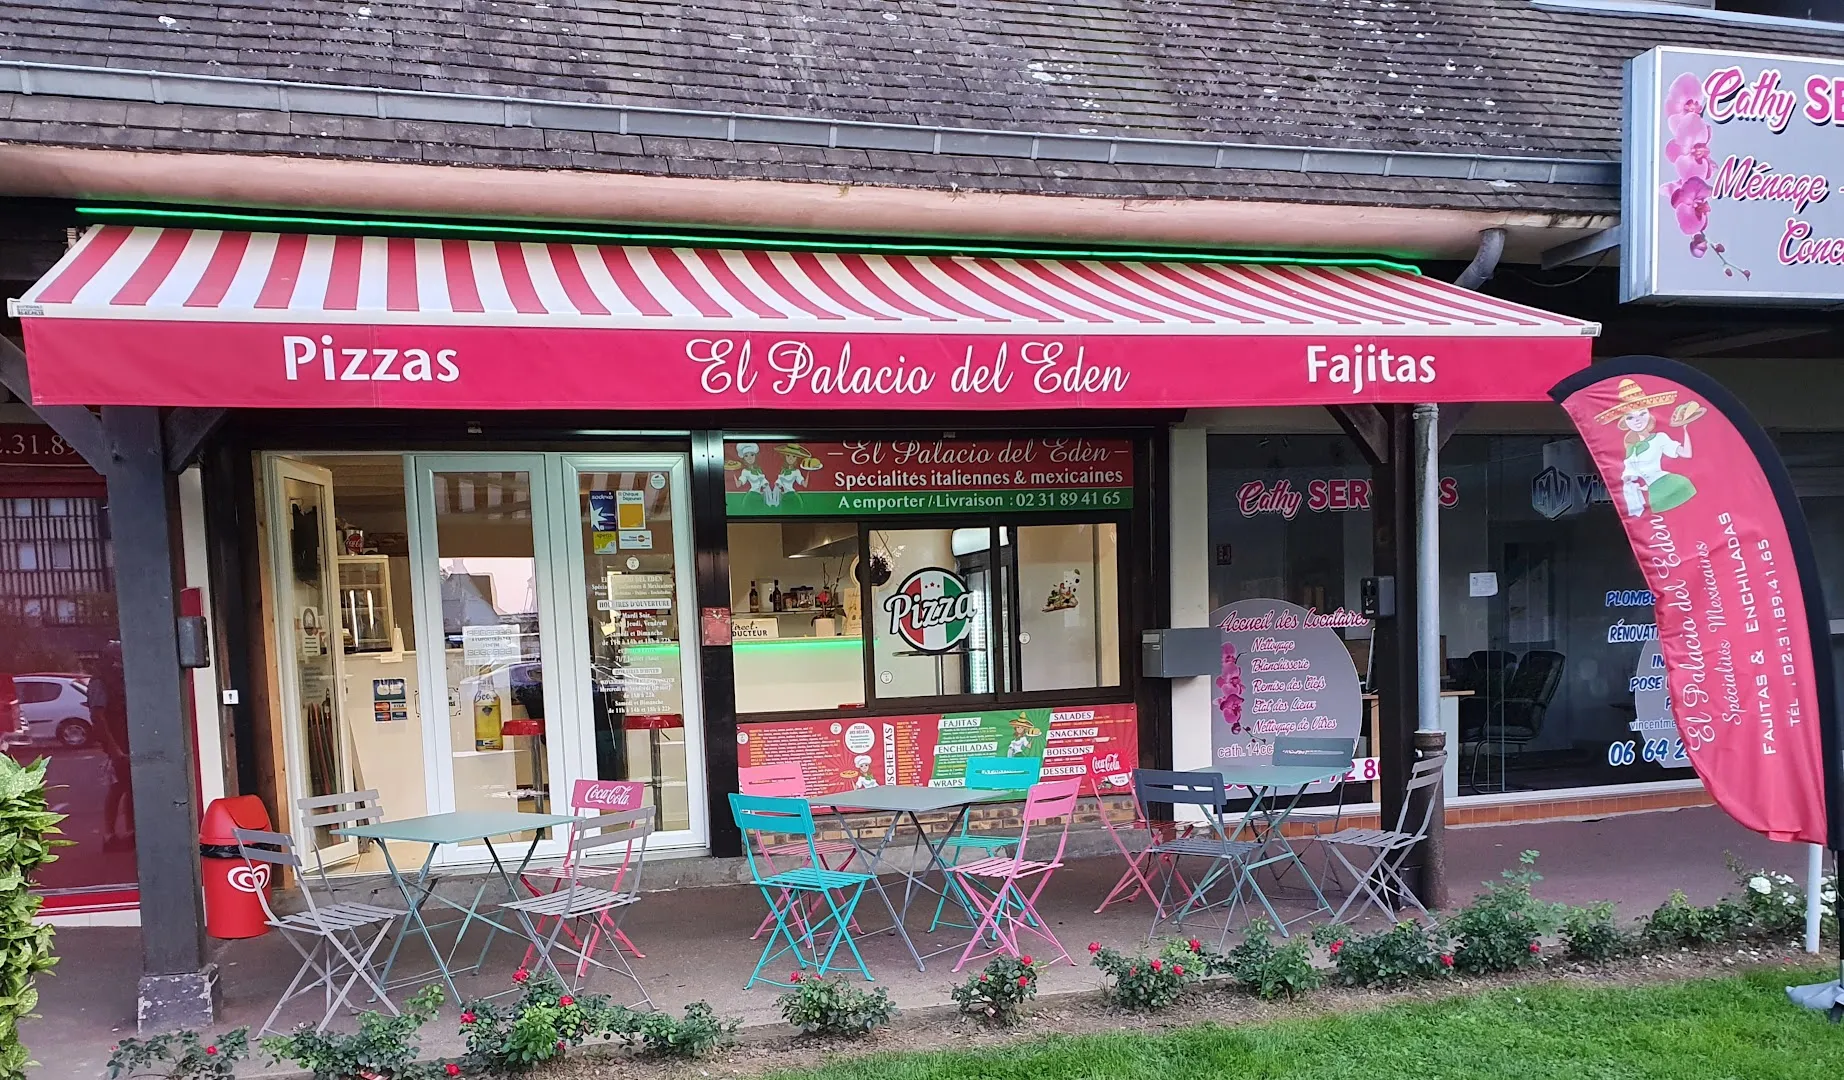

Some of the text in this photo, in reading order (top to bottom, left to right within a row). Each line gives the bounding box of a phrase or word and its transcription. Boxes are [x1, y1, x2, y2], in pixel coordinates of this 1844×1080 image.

[1702, 65, 1796, 134] Cathy
[1711, 155, 1829, 214] Ménage
[283, 334, 460, 382] Pizzas
[685, 338, 1131, 395] El Palacio del Eden
[1306, 343, 1437, 395] Fajitas
[842, 439, 887, 465] El
[891, 439, 995, 465] Palacio
[998, 438, 1038, 463] del
[834, 466, 1124, 491] Spécialités italiennes & mexicaines
[838, 496, 850, 509] A
[852, 495, 925, 511] emporter
[936, 493, 1003, 508] Livraison
[1016, 493, 1035, 507] 02
[1038, 492, 1055, 507] 31
[1060, 491, 1078, 506] 89
[1081, 491, 1098, 506] 41
[1102, 491, 1121, 505] 65
[1236, 479, 1302, 521] Cathy
[1663, 578, 1694, 613] del
[1757, 538, 1796, 676] 02.31.89.41.65
[884, 589, 977, 634] Pizza
[1216, 609, 1274, 633] Accueil
[1275, 608, 1299, 630] des
[1251, 636, 1295, 654] Nettoyage
[1718, 511, 1777, 756] FAJITAS & ENCHILADAS
[1252, 658, 1310, 674] Blanchisserie
[1677, 615, 1710, 709] Palacio
[1252, 678, 1285, 694] Remise
[1286, 677, 1302, 691] des
[1630, 676, 1663, 692] POSE
[1053, 712, 1092, 721] SALADES
[1273, 698, 1289, 712] des
[1290, 697, 1316, 711] Lieux
[943, 718, 978, 728] FAJITAS
[1049, 728, 1095, 738] SNACKING
[1253, 715, 1337, 736] Nettoyage de Vitres
[1684, 711, 1716, 752] El
[938, 743, 993, 754] ENCHILADAS
[1608, 740, 1636, 767] 06
[1642, 737, 1670, 762] 64
[933, 778, 963, 787] WRAPS
[1043, 766, 1085, 776] DESSERTS
